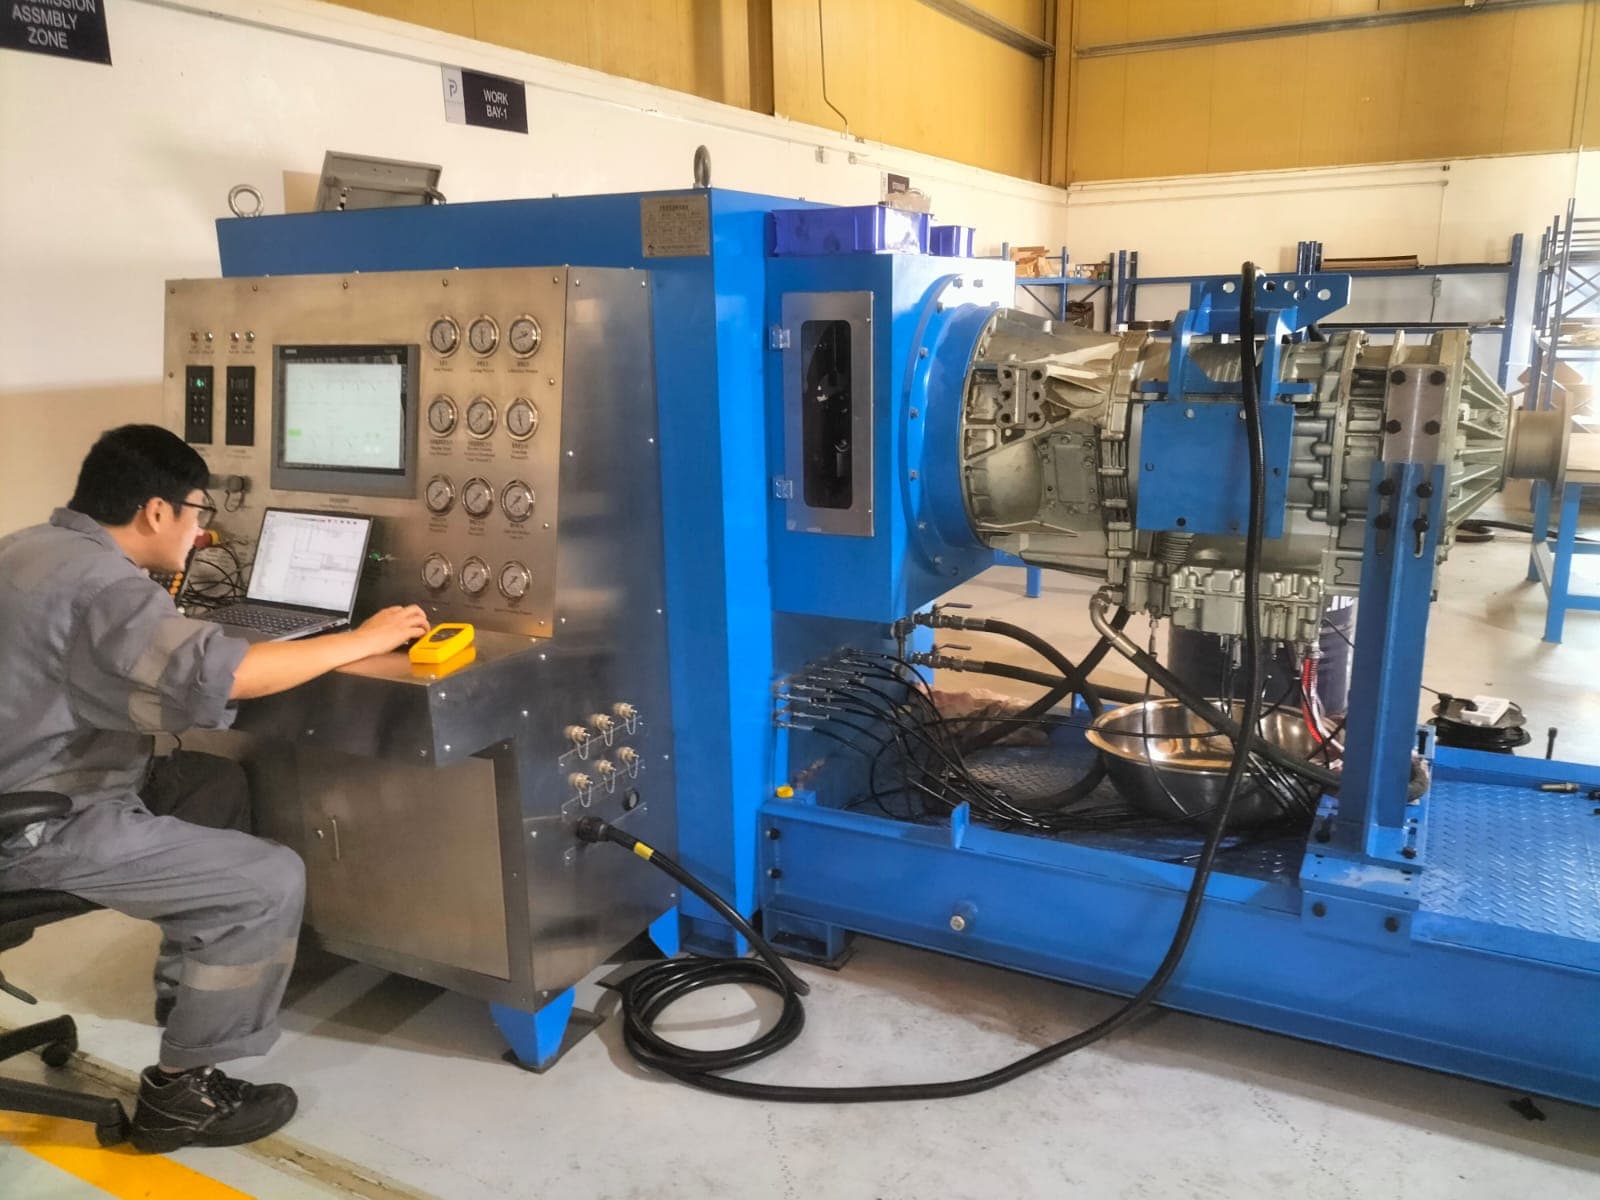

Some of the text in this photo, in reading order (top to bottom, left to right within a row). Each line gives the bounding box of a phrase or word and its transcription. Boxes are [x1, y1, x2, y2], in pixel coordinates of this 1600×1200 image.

[12, 4, 77, 30] ASSMBLY
[27, 26, 69, 49] ZONE
[483, 88, 509, 105] WORK
[486, 105, 508, 119] BAY-1
